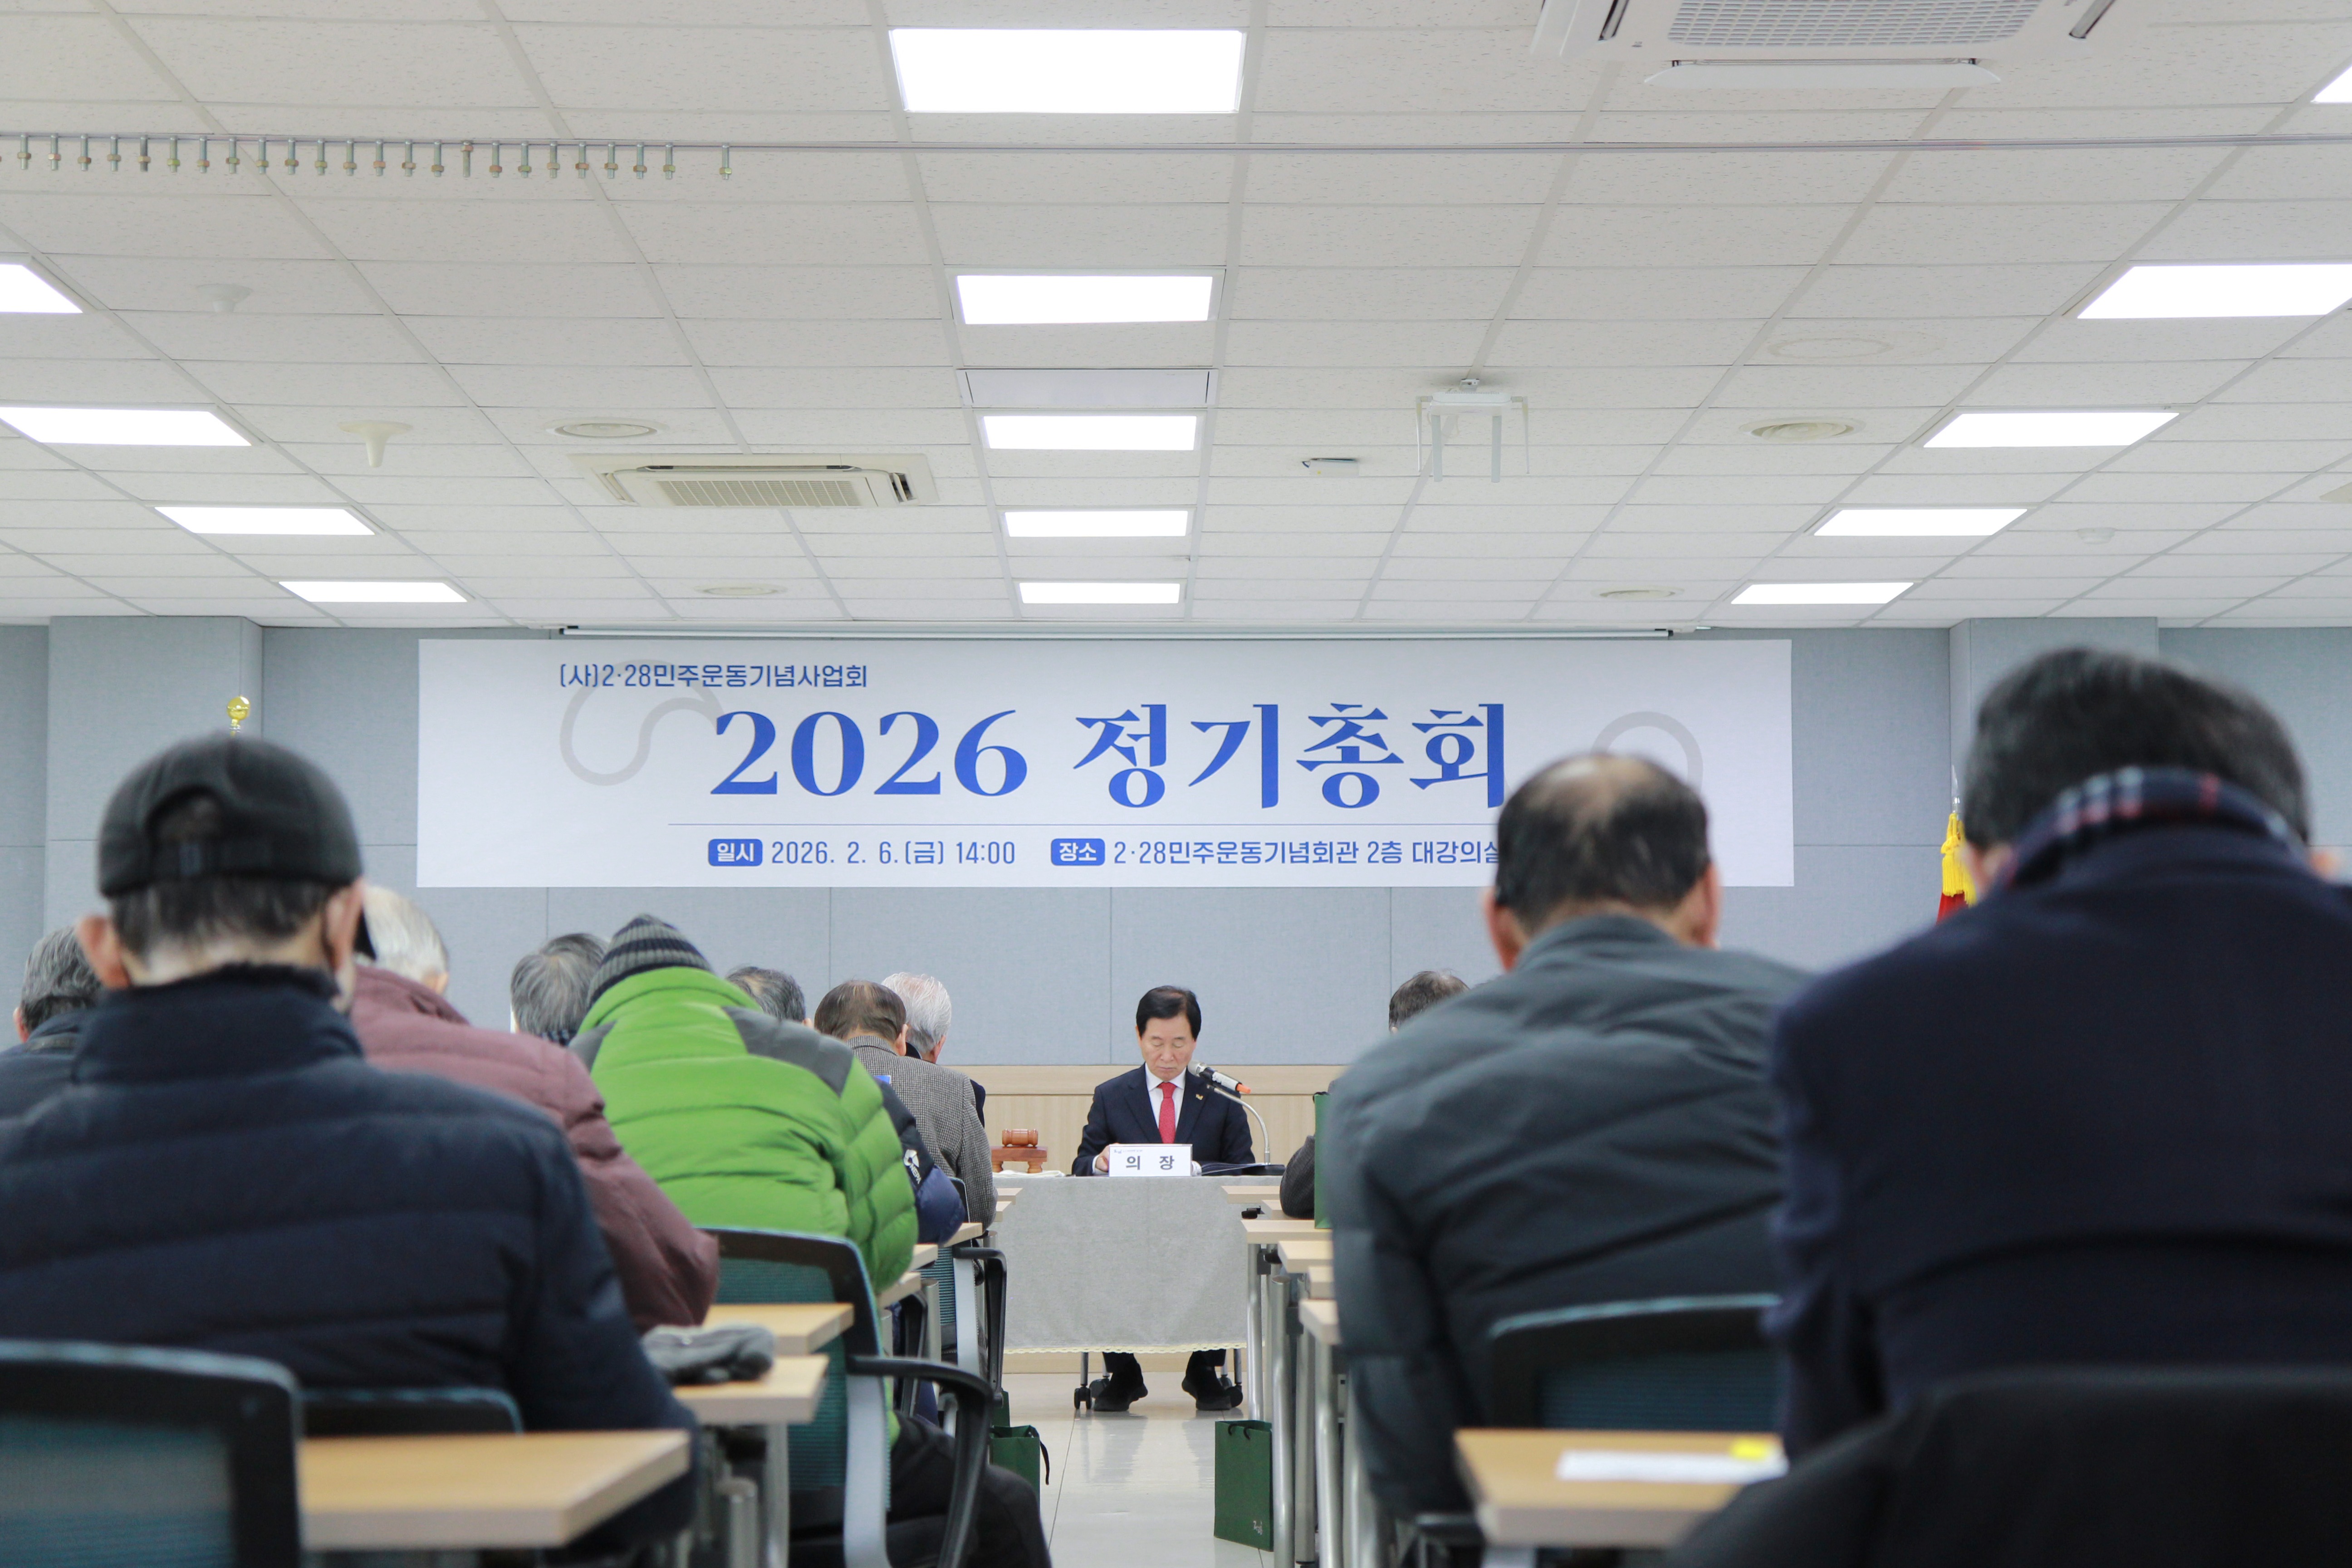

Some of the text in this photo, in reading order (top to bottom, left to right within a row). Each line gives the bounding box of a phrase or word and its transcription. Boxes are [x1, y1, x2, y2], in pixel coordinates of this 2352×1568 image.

[710, 703, 1505, 809] 2026 정기총회
[716, 843, 755, 863] 일시
[772, 841, 835, 864] 2026.
[847, 841, 867, 864] 2.
[956, 841, 1015, 864] 14:00
[1059, 842, 1098, 862] 장소
[1114, 840, 1359, 864] 2·28민주운동기념회관
[1367, 841, 1403, 864] 2층
[909, 1163, 921, 1184] NEPA
